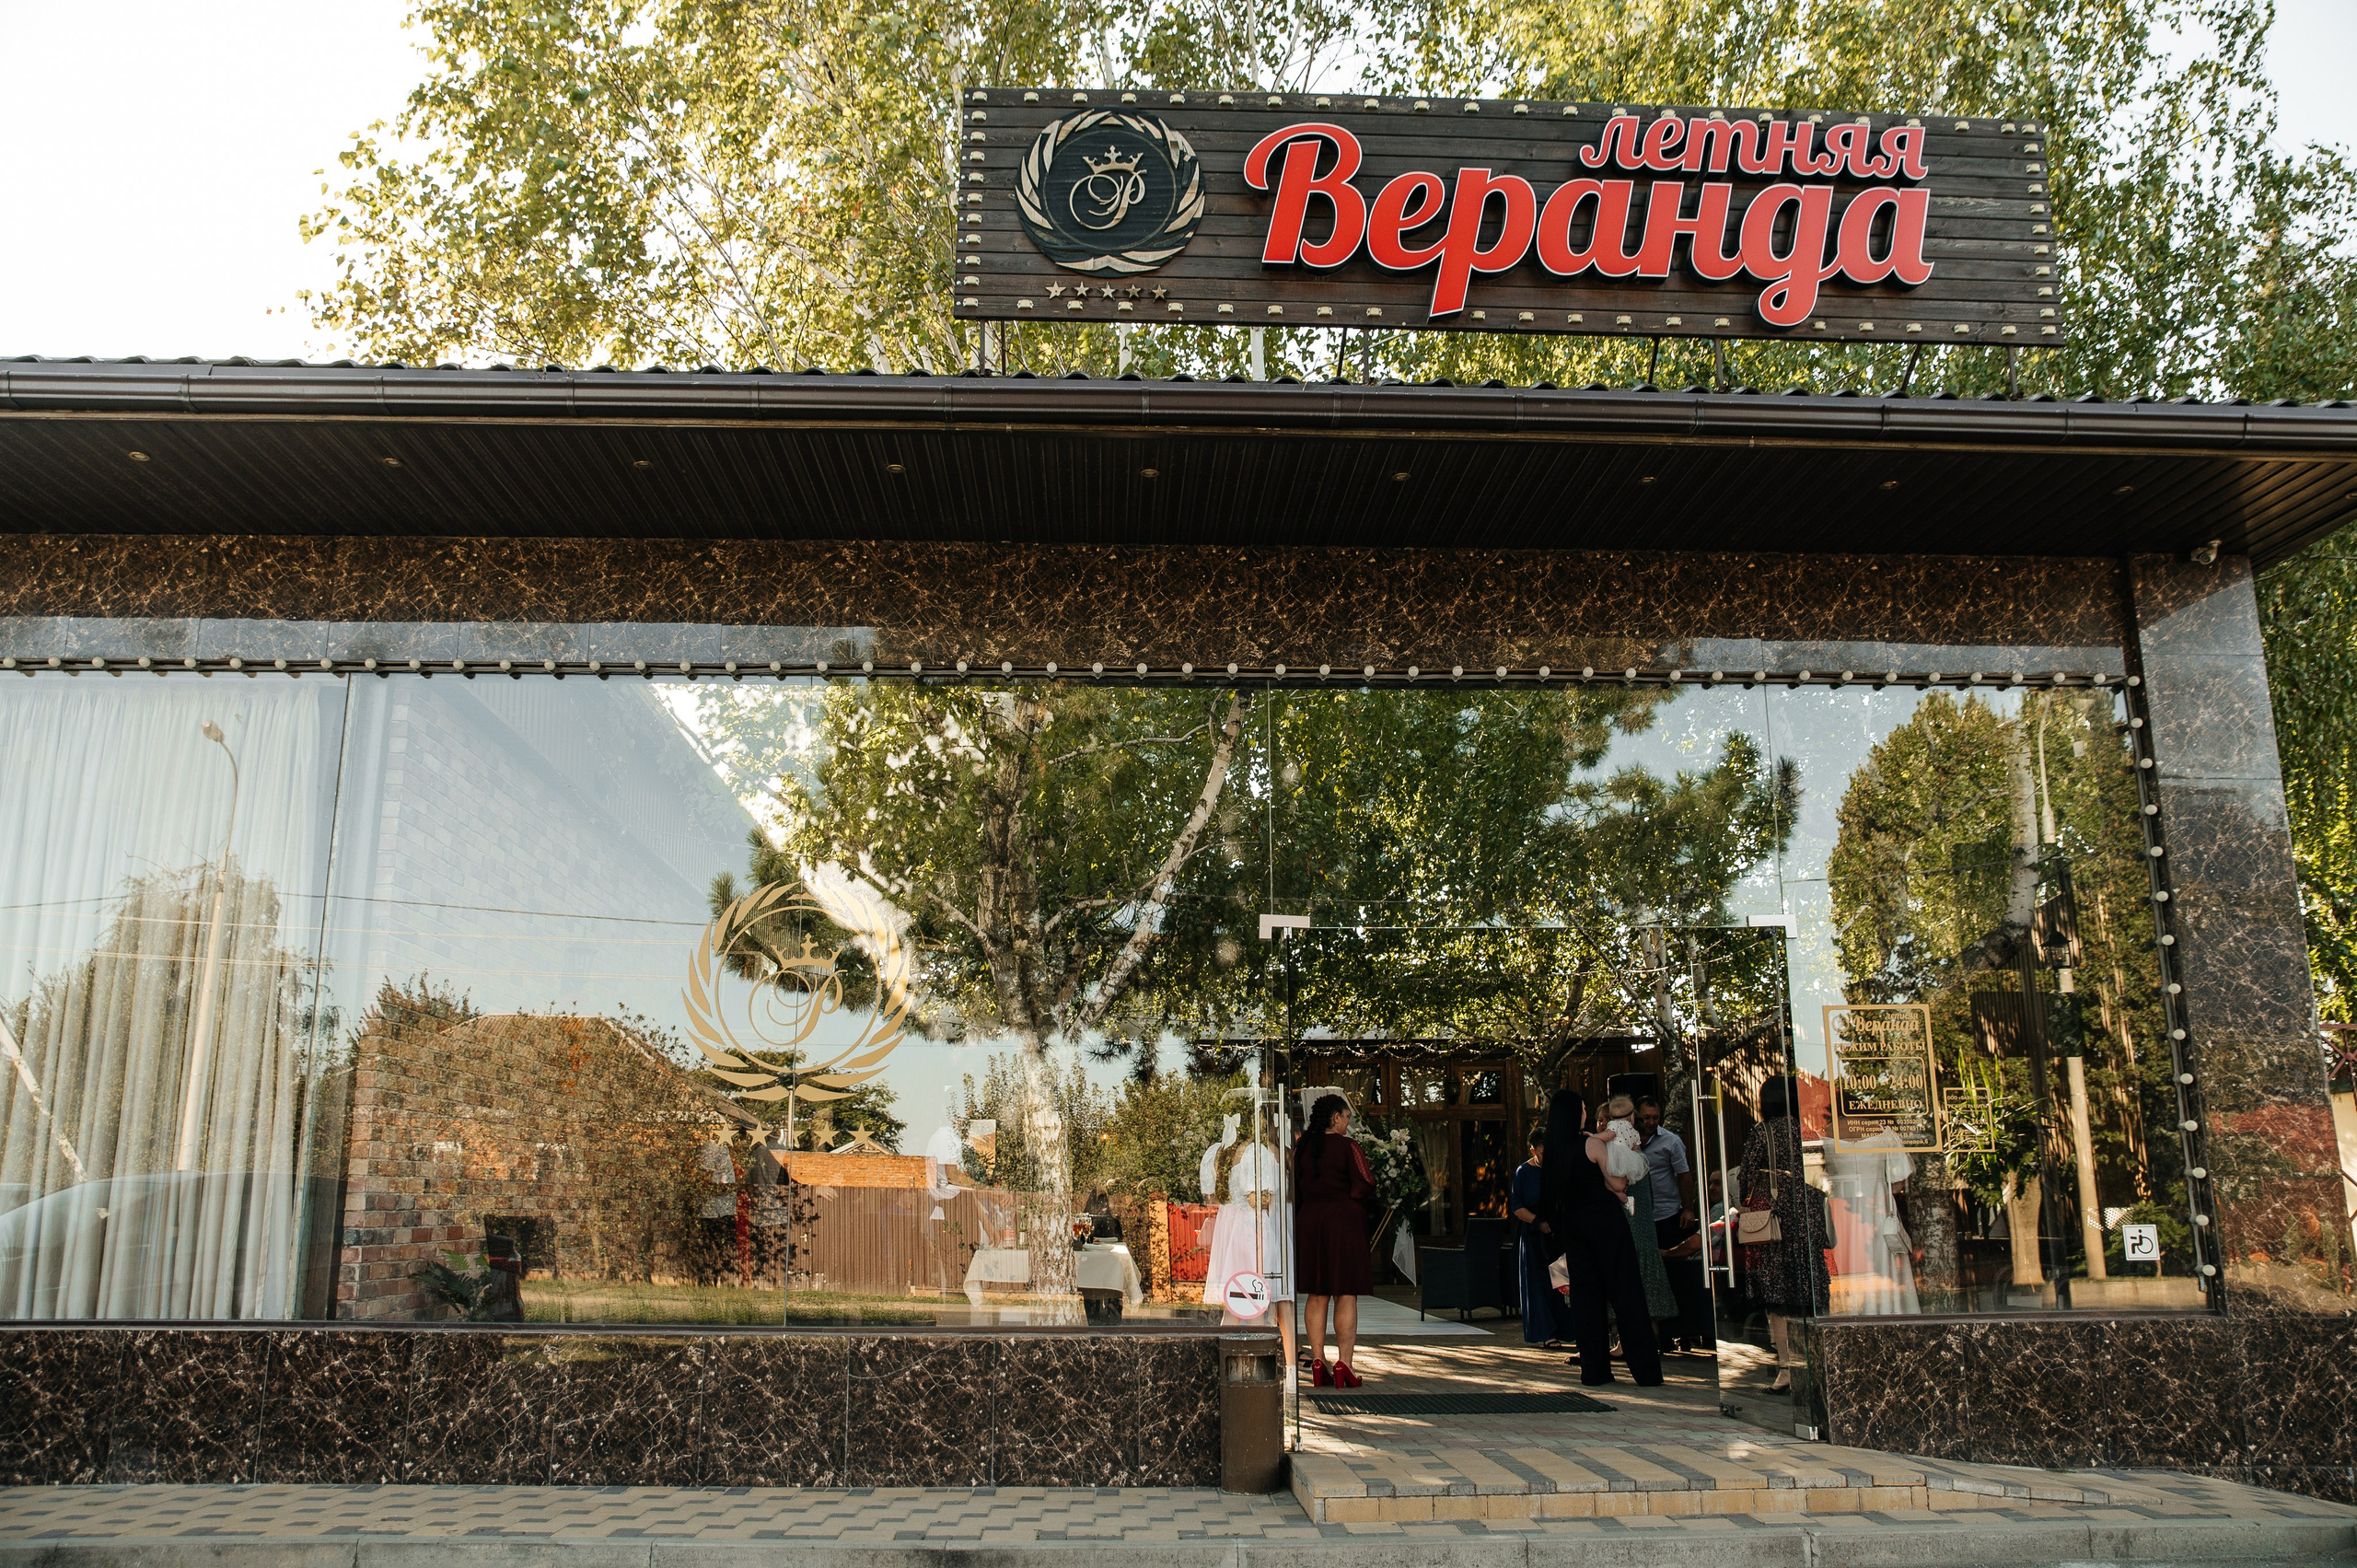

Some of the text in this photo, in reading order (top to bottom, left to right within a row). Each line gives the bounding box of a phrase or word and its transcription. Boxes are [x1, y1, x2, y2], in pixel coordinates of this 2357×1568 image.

[1579, 115, 1929, 181] летняя
[1243, 122, 1935, 327] Веранда
[1854, 1016, 1920, 1036] Веранда
[1834, 1041, 1926, 1051] РЕЖИМ РАБОТЫ
[1843, 1074, 1877, 1090] 10:00
[1889, 1074, 1923, 1089] 24:00
[1849, 1099, 1922, 1111] ЕЖЕДНЕВНО
